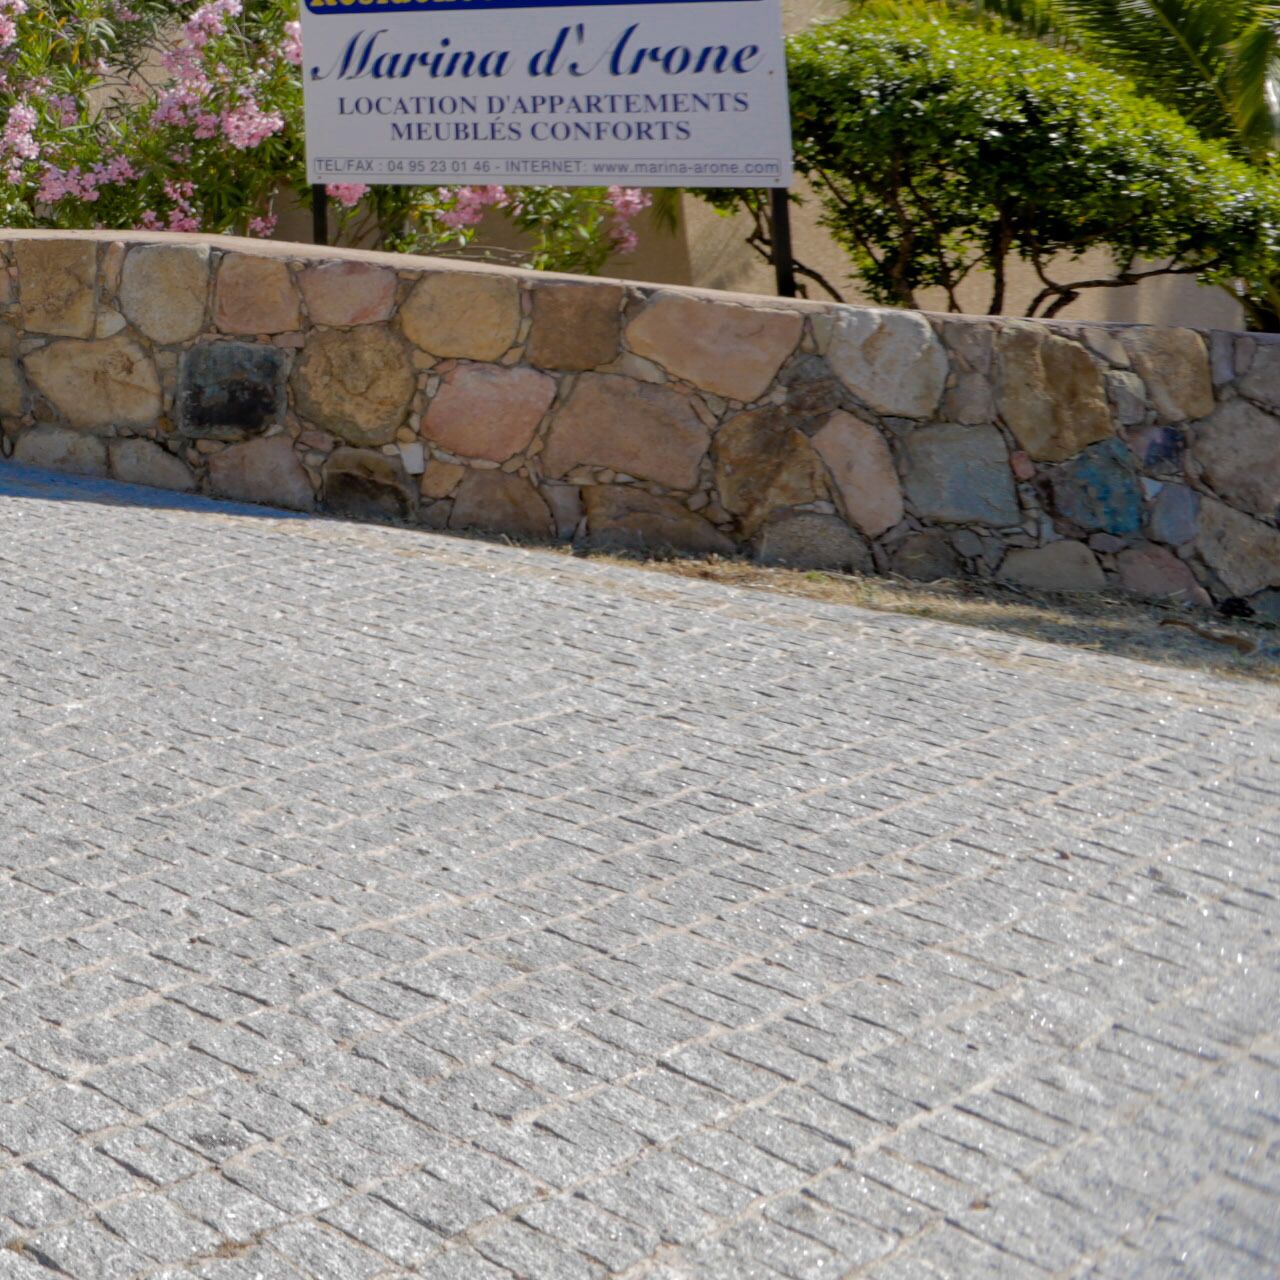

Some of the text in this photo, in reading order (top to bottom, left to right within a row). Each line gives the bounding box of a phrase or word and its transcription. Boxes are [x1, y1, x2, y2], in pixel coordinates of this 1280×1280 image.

[310, 22, 766, 81] Marina d'Arone
[337, 91, 750, 116] LOCATION D'APPARTEMENTS
[390, 116, 692, 141] MEUBLÉS CONFORTS
[316, 159, 374, 172] TEL/FAX
[388, 160, 403, 172] 04
[409, 160, 425, 173] 95
[430, 160, 447, 173] 23
[451, 160, 468, 172] 01
[473, 160, 491, 173] 46
[593, 159, 780, 175] www.marina-arone.com
